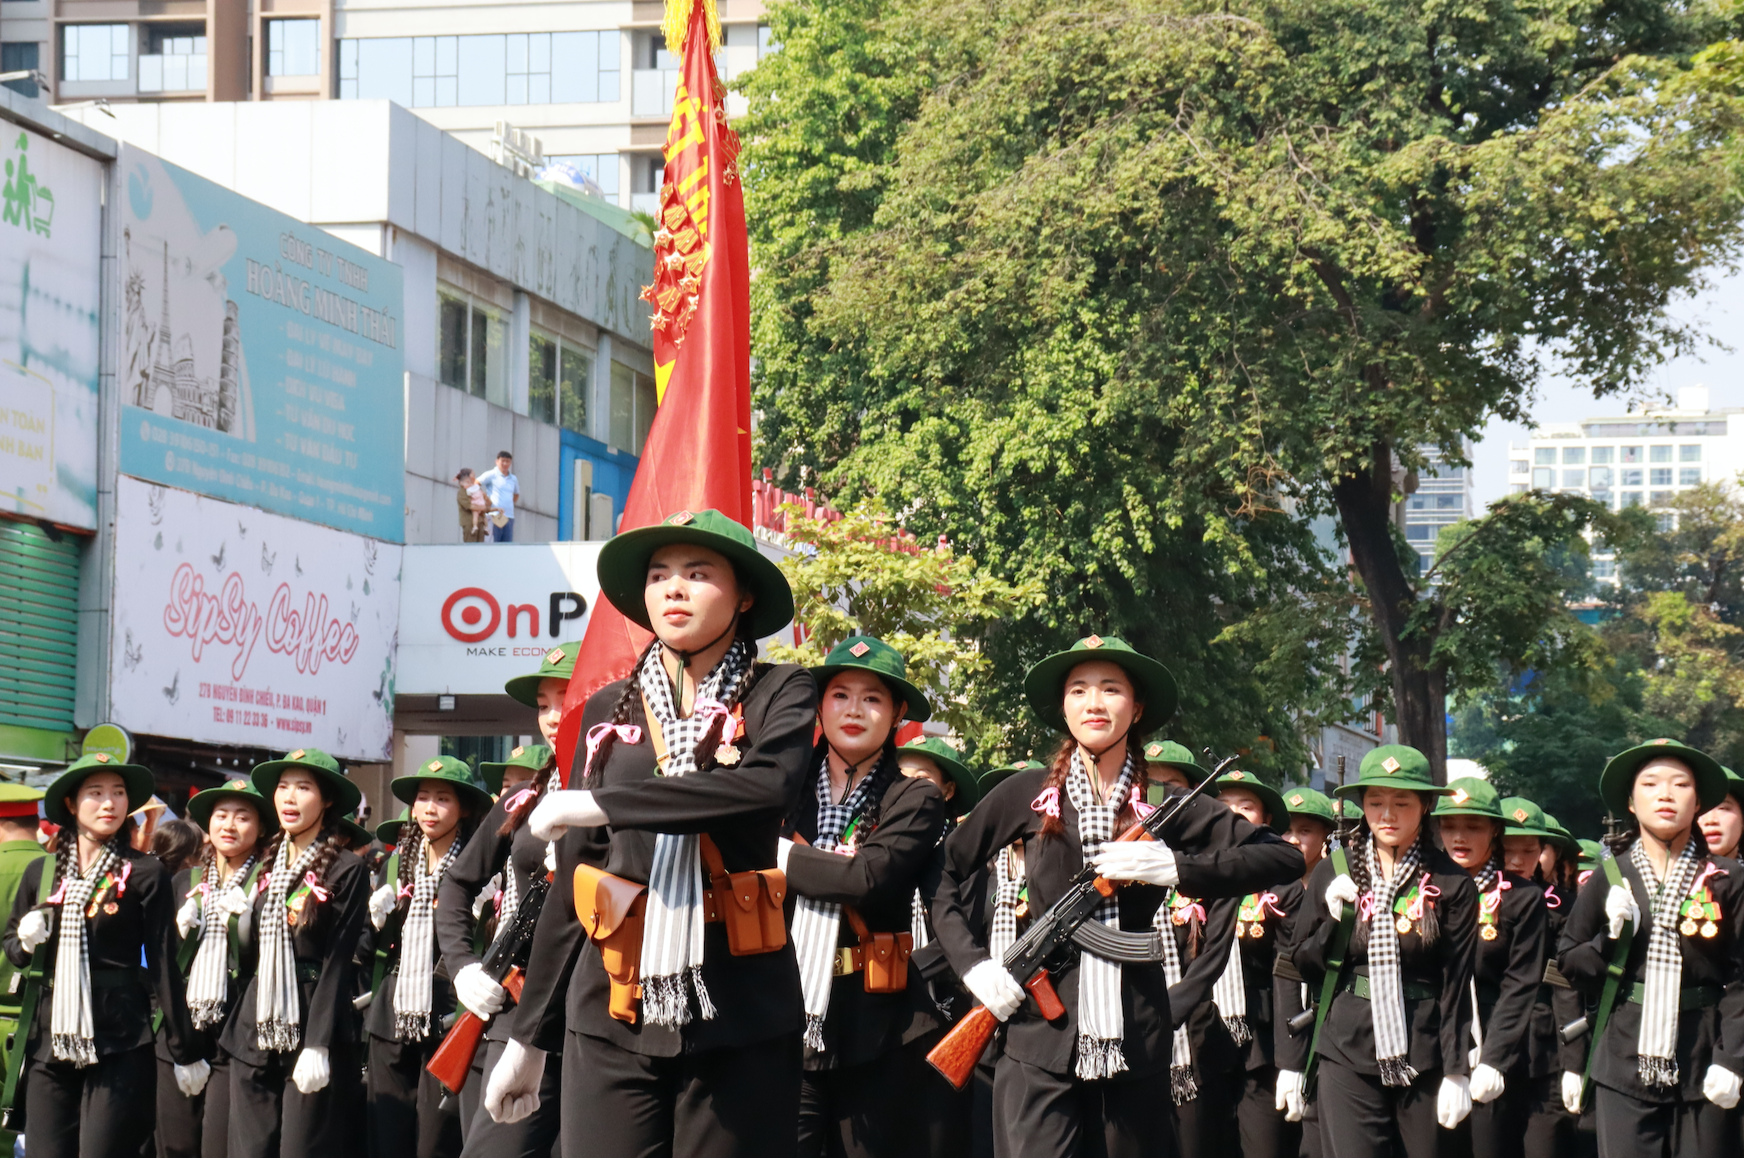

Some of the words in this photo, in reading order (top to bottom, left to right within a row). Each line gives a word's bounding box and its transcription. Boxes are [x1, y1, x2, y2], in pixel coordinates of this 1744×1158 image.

[280, 231, 313, 270] CÔNG
[317, 247, 333, 277] TY
[337, 256, 369, 293] TNHH
[246, 257, 311, 315] HOÀNG
[313, 285, 358, 335] MINH
[360, 305, 397, 350] THÁI
[265, 581, 360, 676] Coffee
[441, 587, 587, 643] OnP
[467, 647, 507, 657] MAKE
[513, 647, 551, 657] ECOM
[213, 706, 225, 723] TEL:
[235, 710, 242, 725] 11
[243, 710, 251, 726] 22
[322, 699, 327, 716] 1
